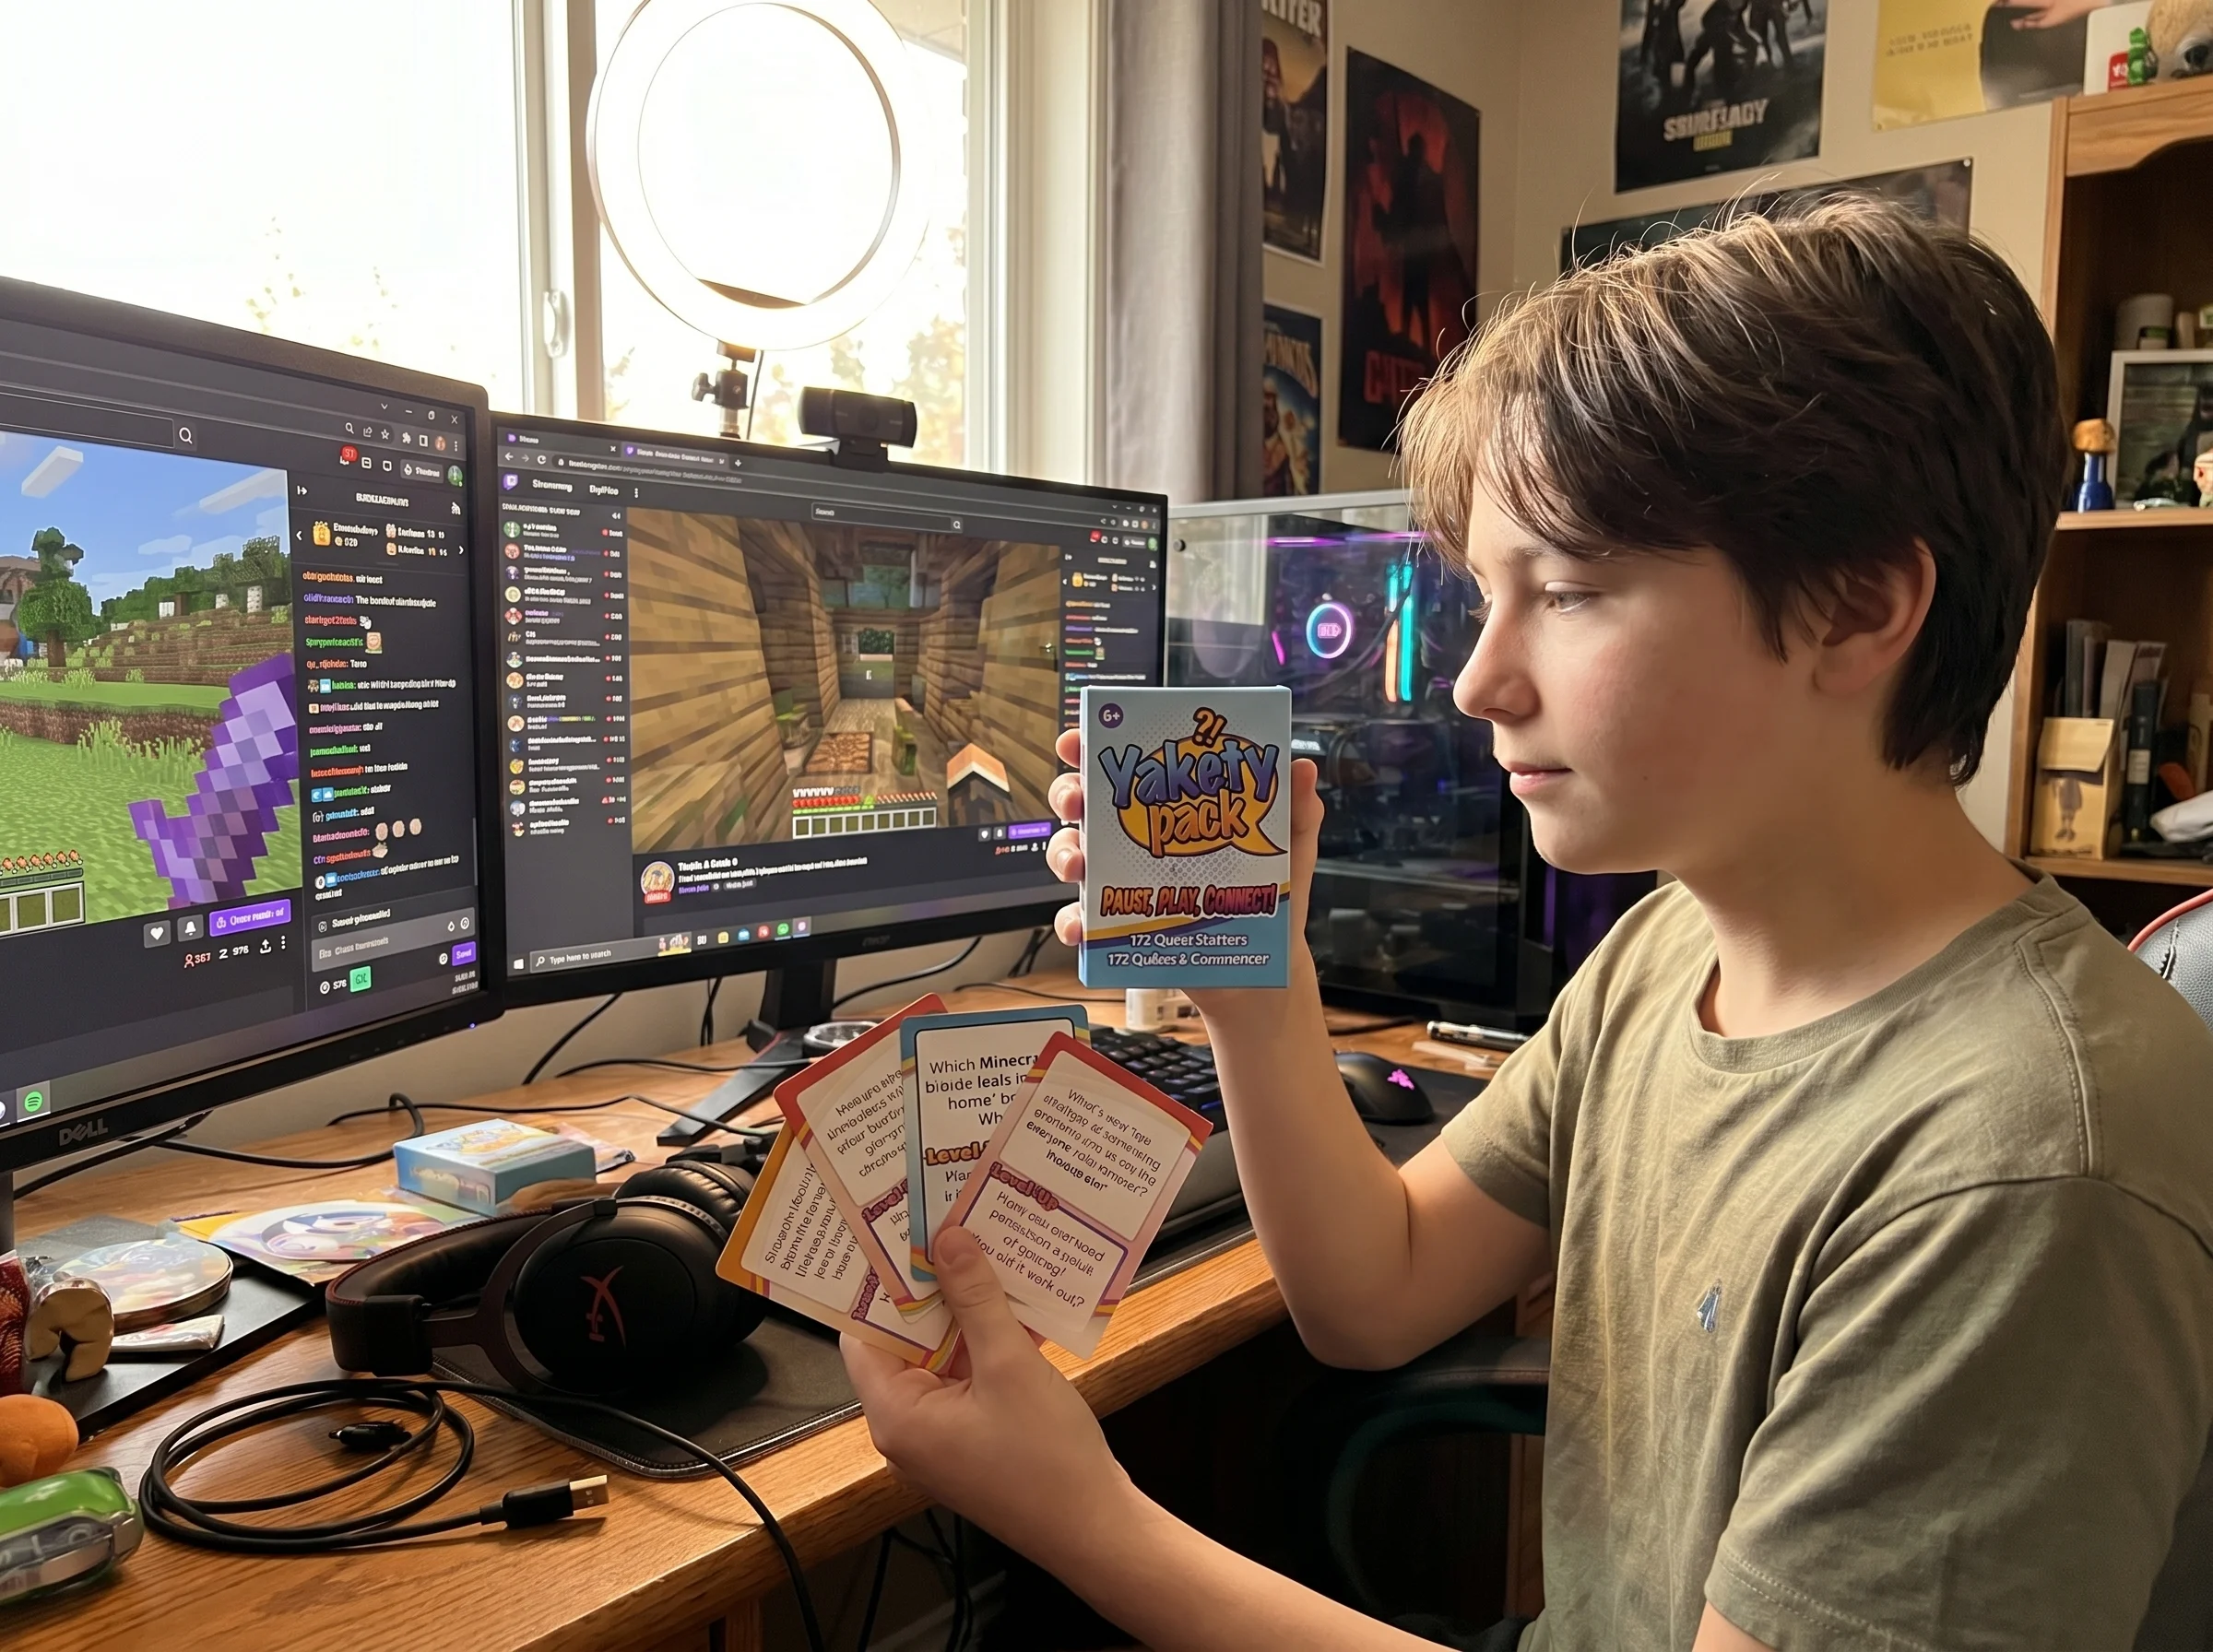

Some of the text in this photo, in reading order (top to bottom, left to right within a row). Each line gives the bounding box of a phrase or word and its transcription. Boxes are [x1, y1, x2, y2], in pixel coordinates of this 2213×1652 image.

[1097, 738, 1280, 809] Yakety
[1149, 788, 1250, 859] pack
[1130, 934, 1151, 947] 172
[550, 956, 565, 965] Type
[1108, 953, 1130, 966] 172
[1178, 953, 1188, 965] &
[929, 1057, 976, 1074] Which
[59, 1117, 109, 1147] DELL
[925, 1140, 982, 1167] Level
